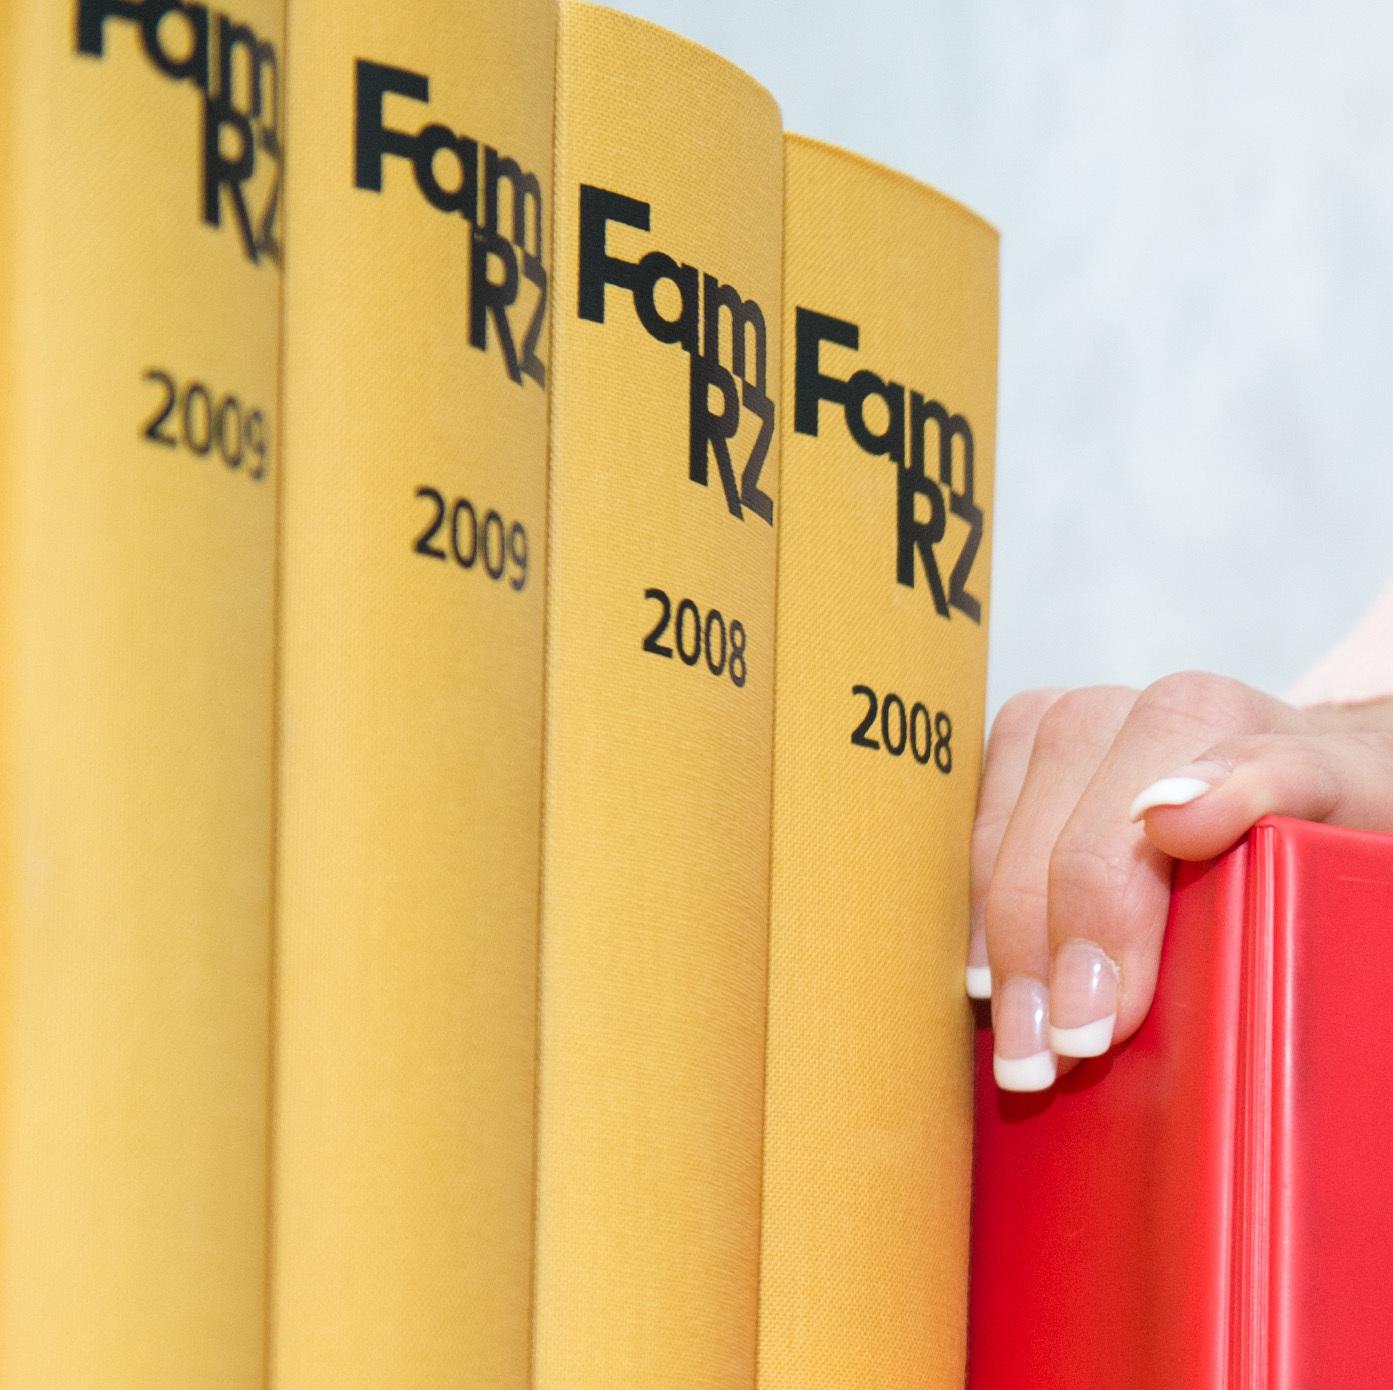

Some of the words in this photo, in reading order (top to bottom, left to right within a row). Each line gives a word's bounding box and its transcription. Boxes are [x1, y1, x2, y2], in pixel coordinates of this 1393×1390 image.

[354, 57, 542, 262] Fam
[468, 222, 546, 390] RZ
[577, 184, 767, 400] Fam
[142, 367, 268, 482] 2009
[688, 348, 775, 527] RZ
[794, 305, 975, 503] Fam
[413, 486, 529, 591] 2009
[896, 464, 984, 626] RZ
[641, 588, 748, 688] 2008
[850, 684, 953, 775] 2008
